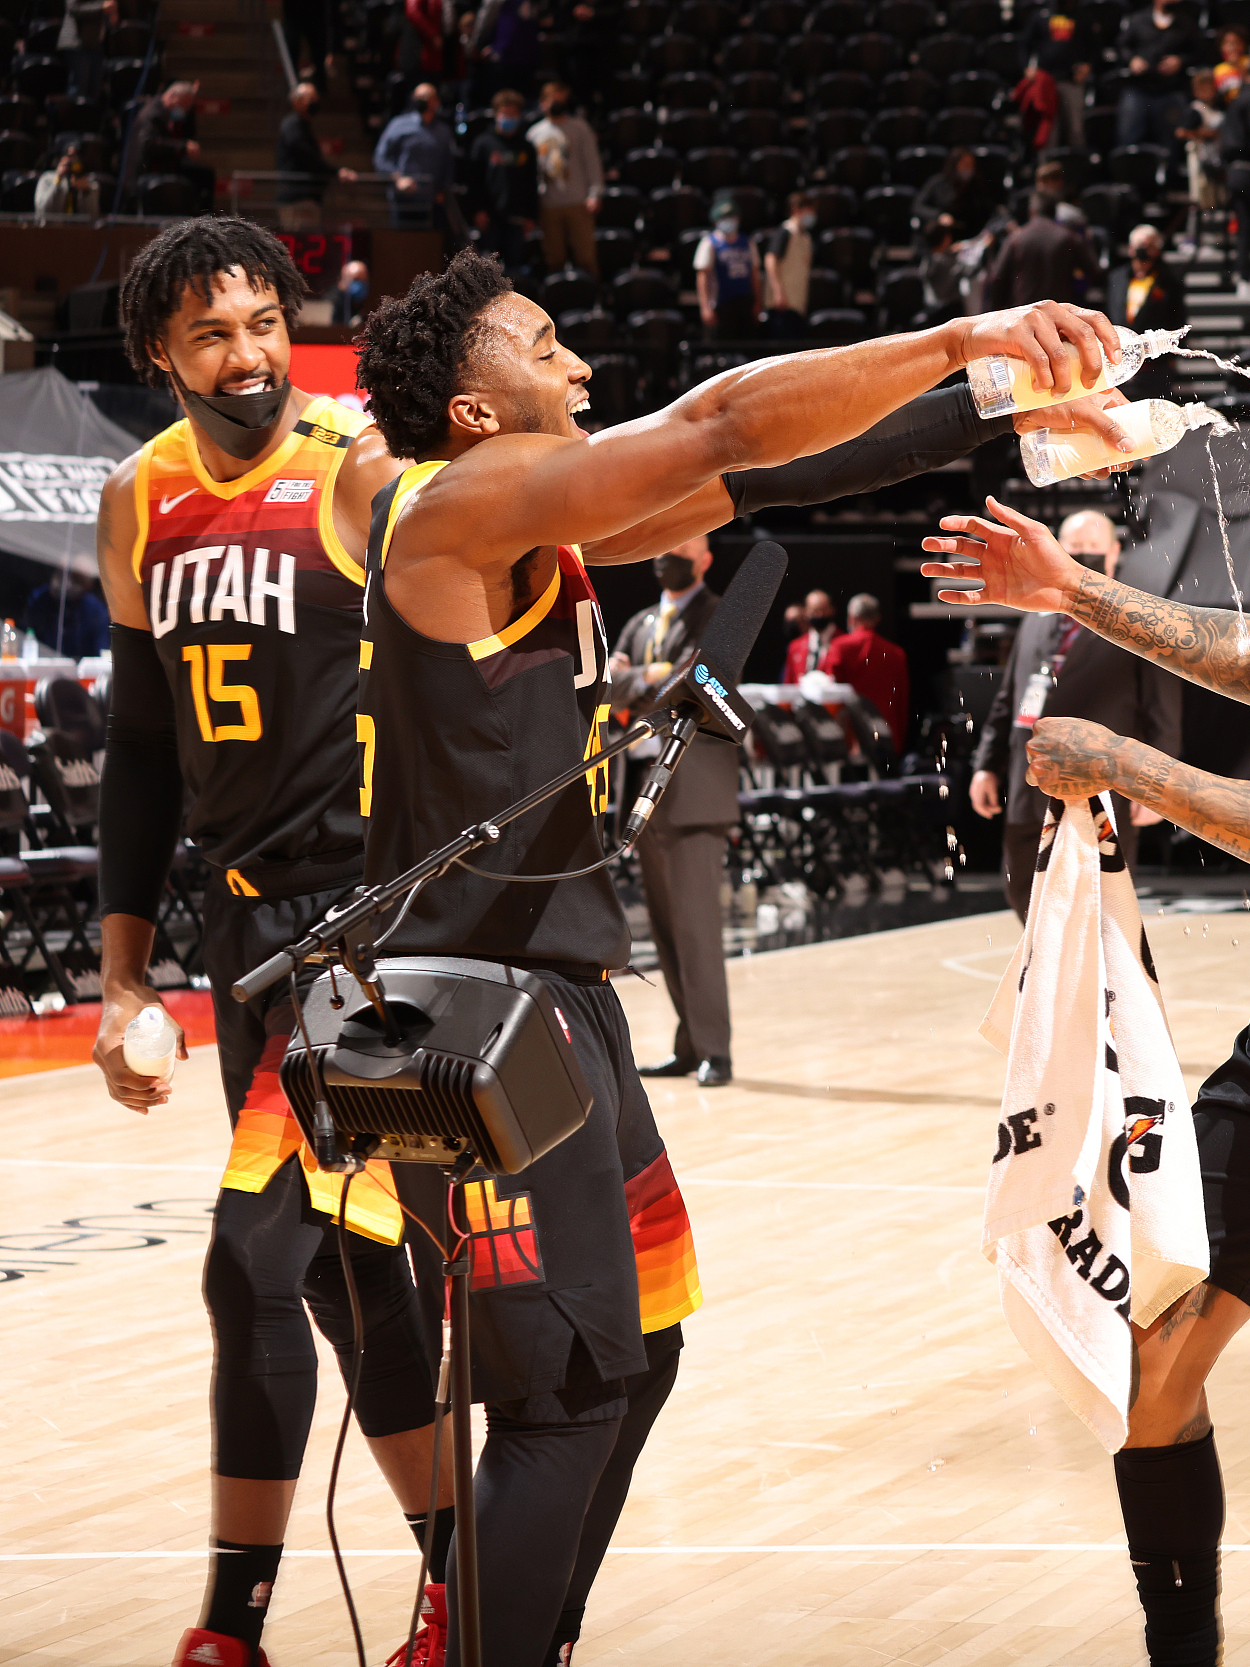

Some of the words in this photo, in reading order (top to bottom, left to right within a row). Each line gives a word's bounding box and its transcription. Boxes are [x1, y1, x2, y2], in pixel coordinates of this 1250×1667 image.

[269, 481, 287, 500] 5
[283, 490, 311, 500] FIGHT
[151, 544, 297, 640] UTAH
[181, 643, 264, 743] 15
[707, 676, 730, 699] AT&T
[702, 682, 747, 732] SPORTSNET
